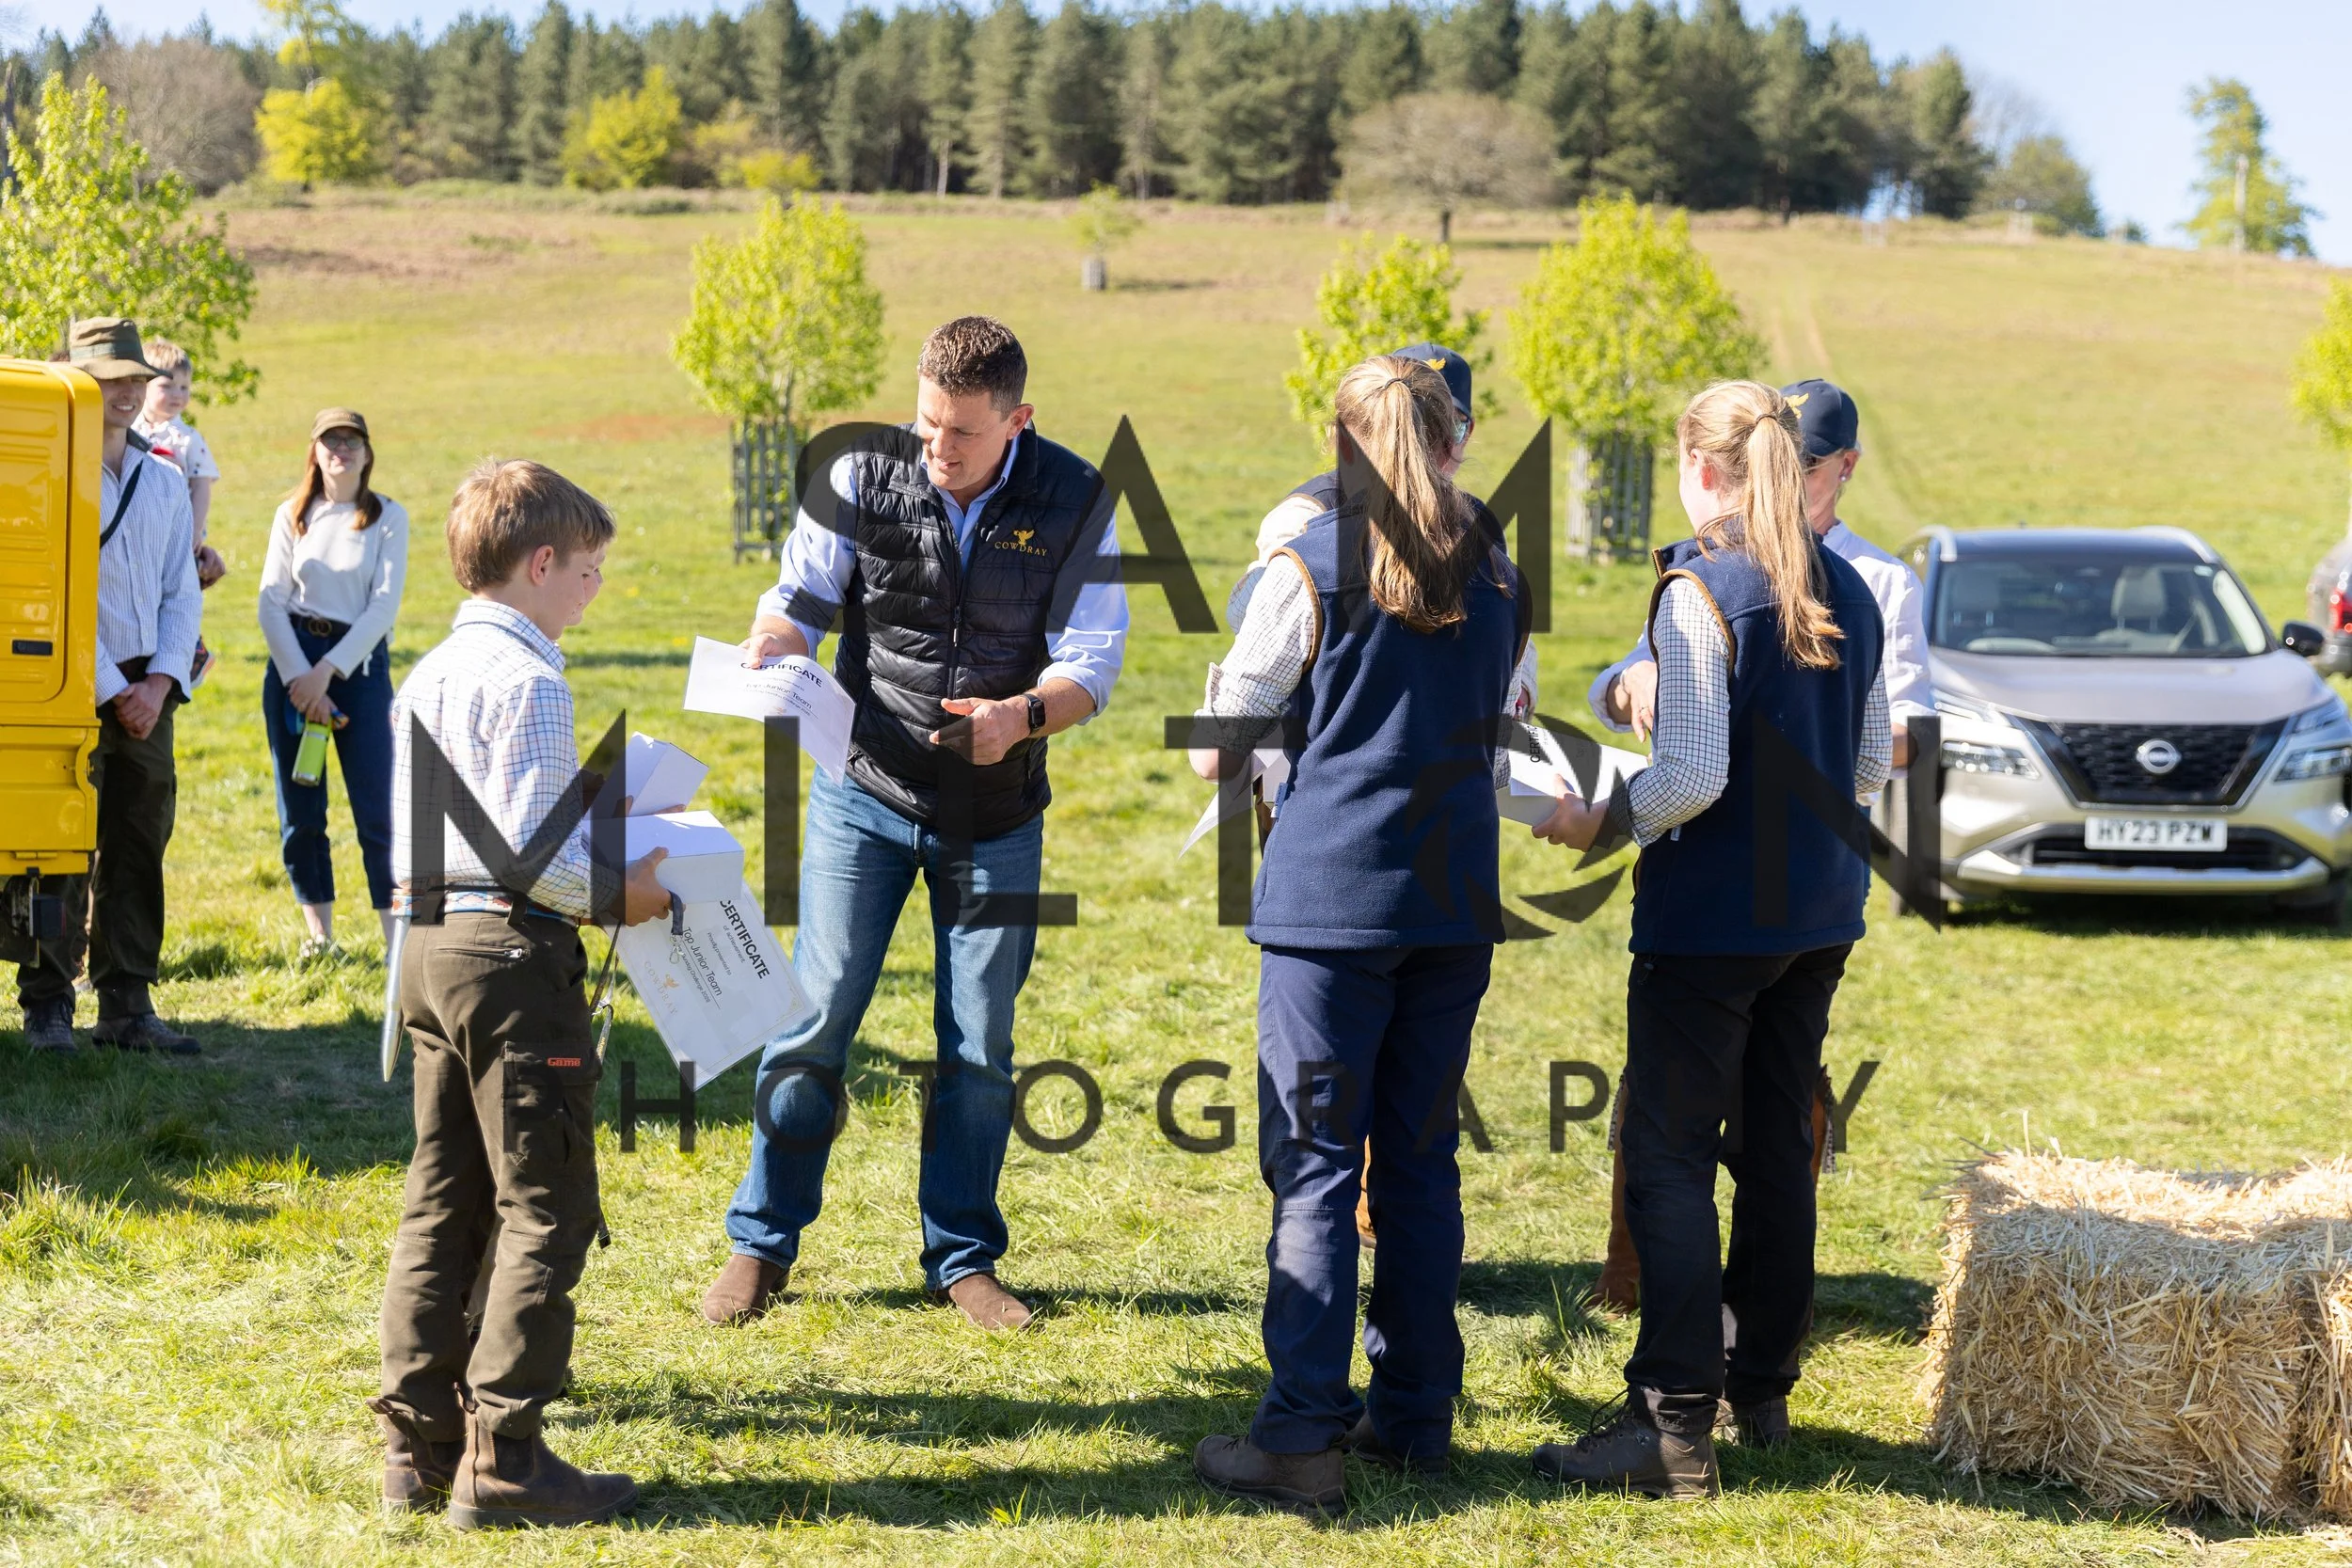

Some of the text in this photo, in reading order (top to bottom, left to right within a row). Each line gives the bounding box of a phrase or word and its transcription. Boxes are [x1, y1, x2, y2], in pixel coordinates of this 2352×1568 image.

[994, 541, 1048, 557] COWDRAY
[740, 662, 822, 688] CRTIFICATE
[792, 691, 812, 709] Team
[2098, 819, 2214, 844] HY23 PZW
[707, 932, 718, 949] Proudly
[714, 947, 730, 971] presented
[725, 931, 746, 964] achievement
[682, 927, 723, 996] Top Junior Team
[644, 960, 678, 1015] COWDRAY
[690, 970, 704, 991] Challenge
[547, 1057, 581, 1068] Game
